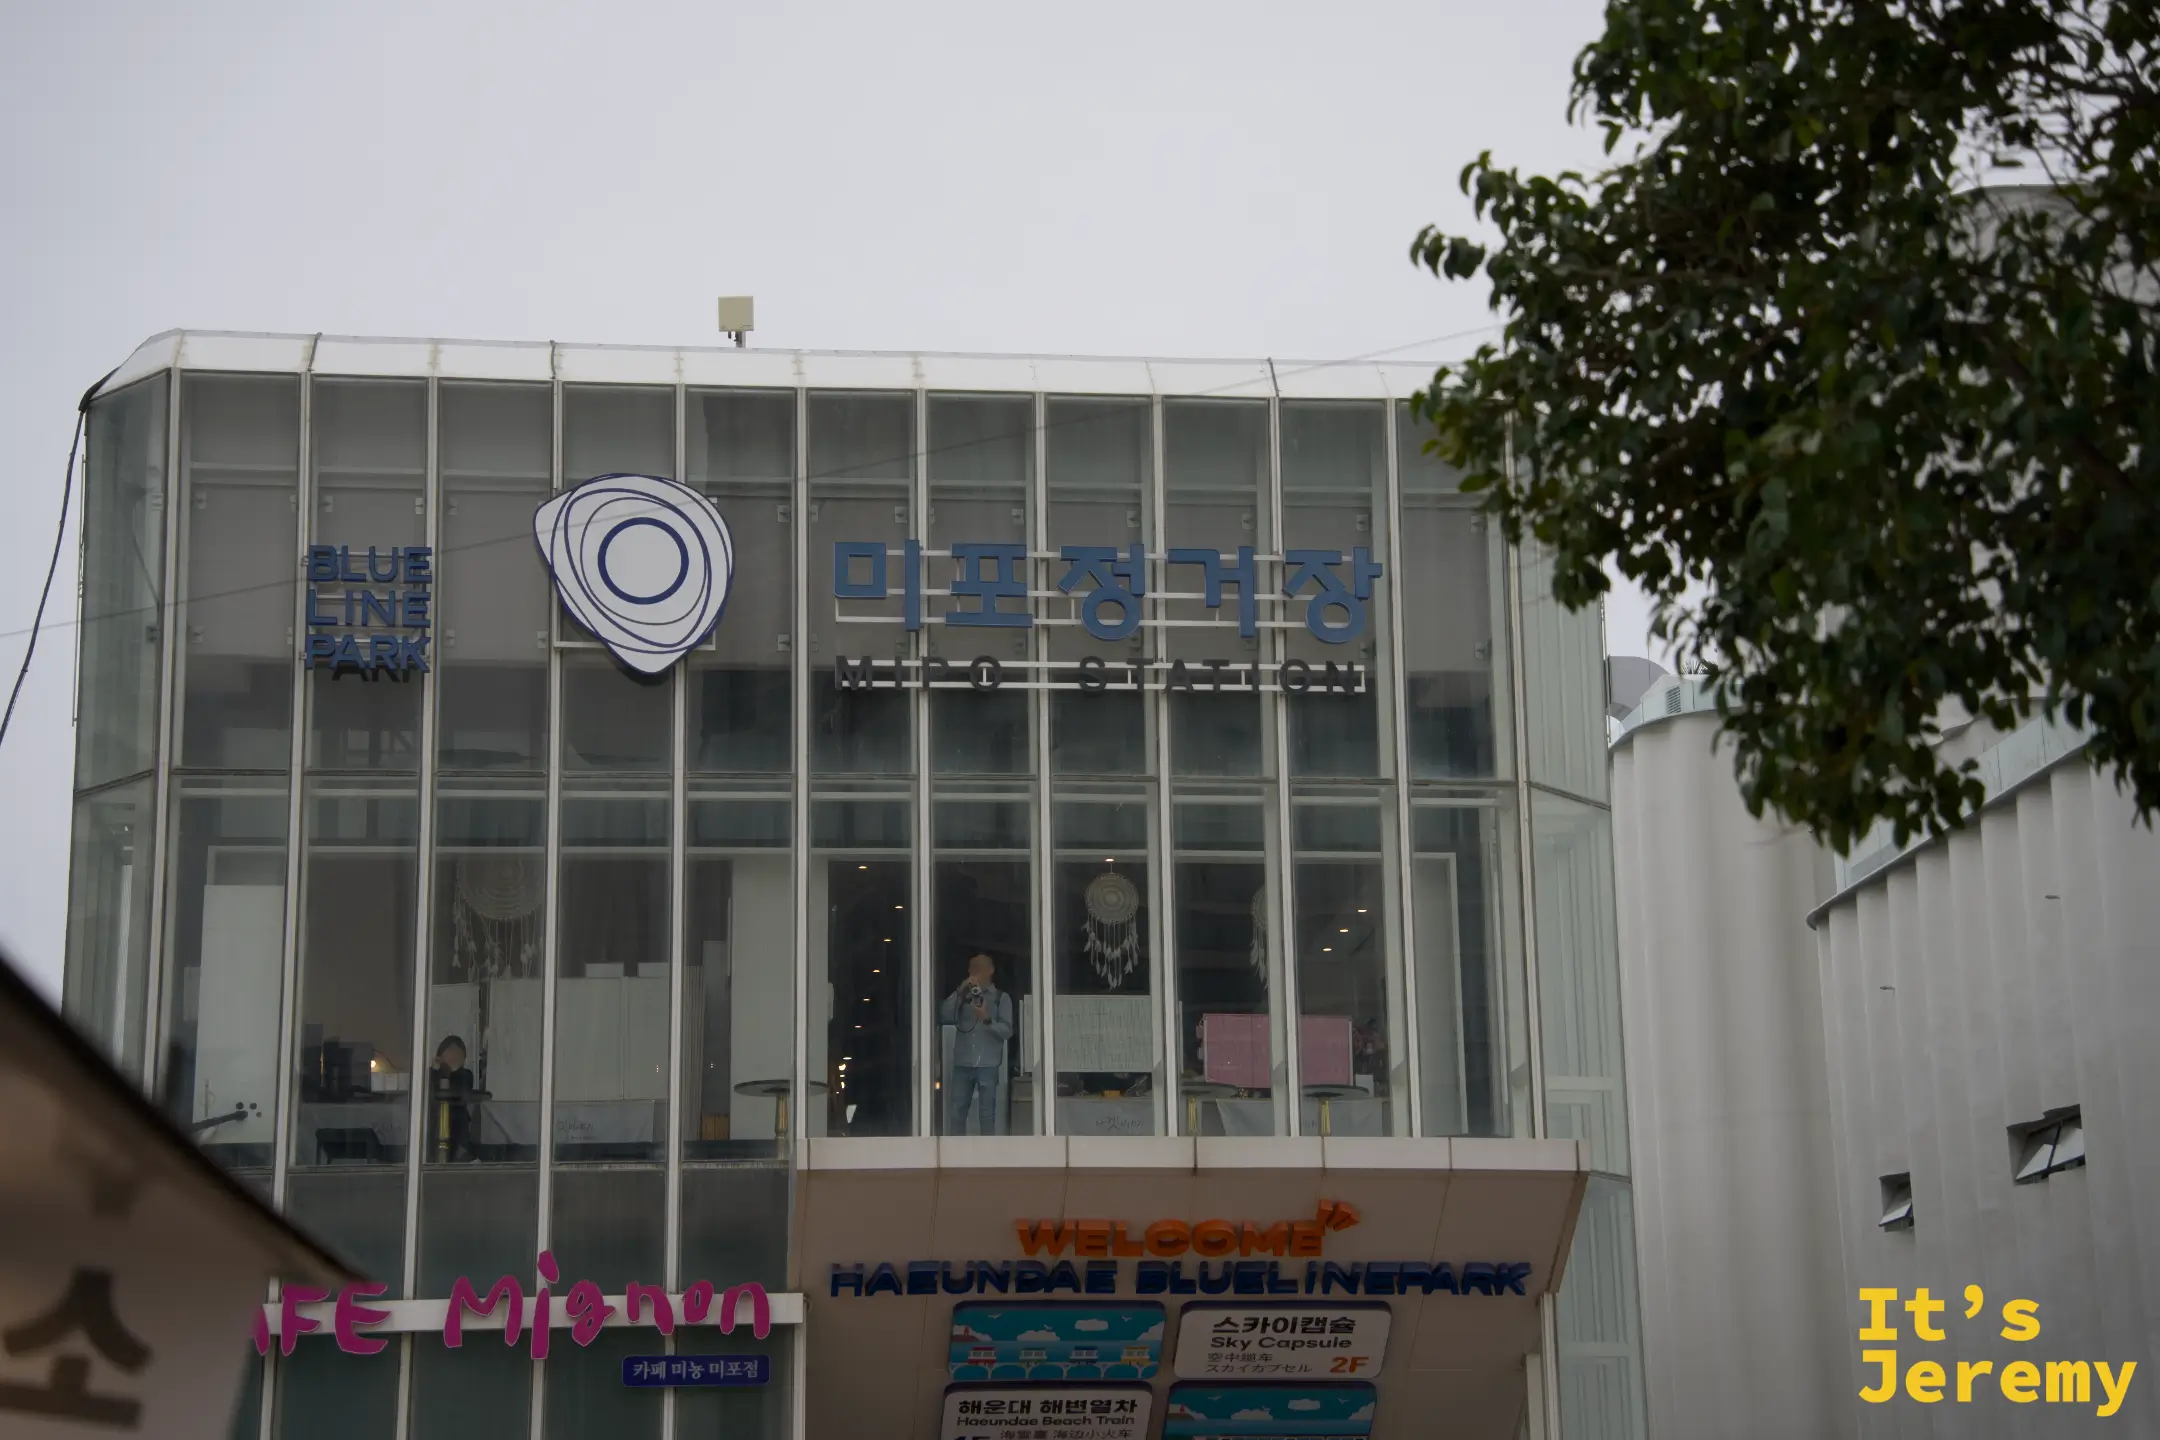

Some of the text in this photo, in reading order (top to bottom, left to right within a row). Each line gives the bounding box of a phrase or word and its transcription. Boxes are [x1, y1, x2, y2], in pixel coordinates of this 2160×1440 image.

[306, 545, 432, 583] BLUE
[306, 590, 431, 627] LINE
[834, 539, 1382, 644] 미포정거장
[305, 634, 431, 673] PARK
[835, 656, 1357, 695] MIPO STATION
[1016, 1219, 1323, 1257] WELCOME
[831, 1260, 1117, 1296] HAEUNDAE
[1210, 1336, 1353, 1351] Sky Capsule
[1211, 1317, 1356, 1334] 스카이캡슐
[632, 1361, 667, 1380] 카페
[709, 1360, 759, 1379] 미포점
[1329, 1356, 1369, 1374] 2F
[957, 1415, 1135, 1426] Haeundae Beach Train
[958, 1399, 1138, 1415] 해운대 해변열차
